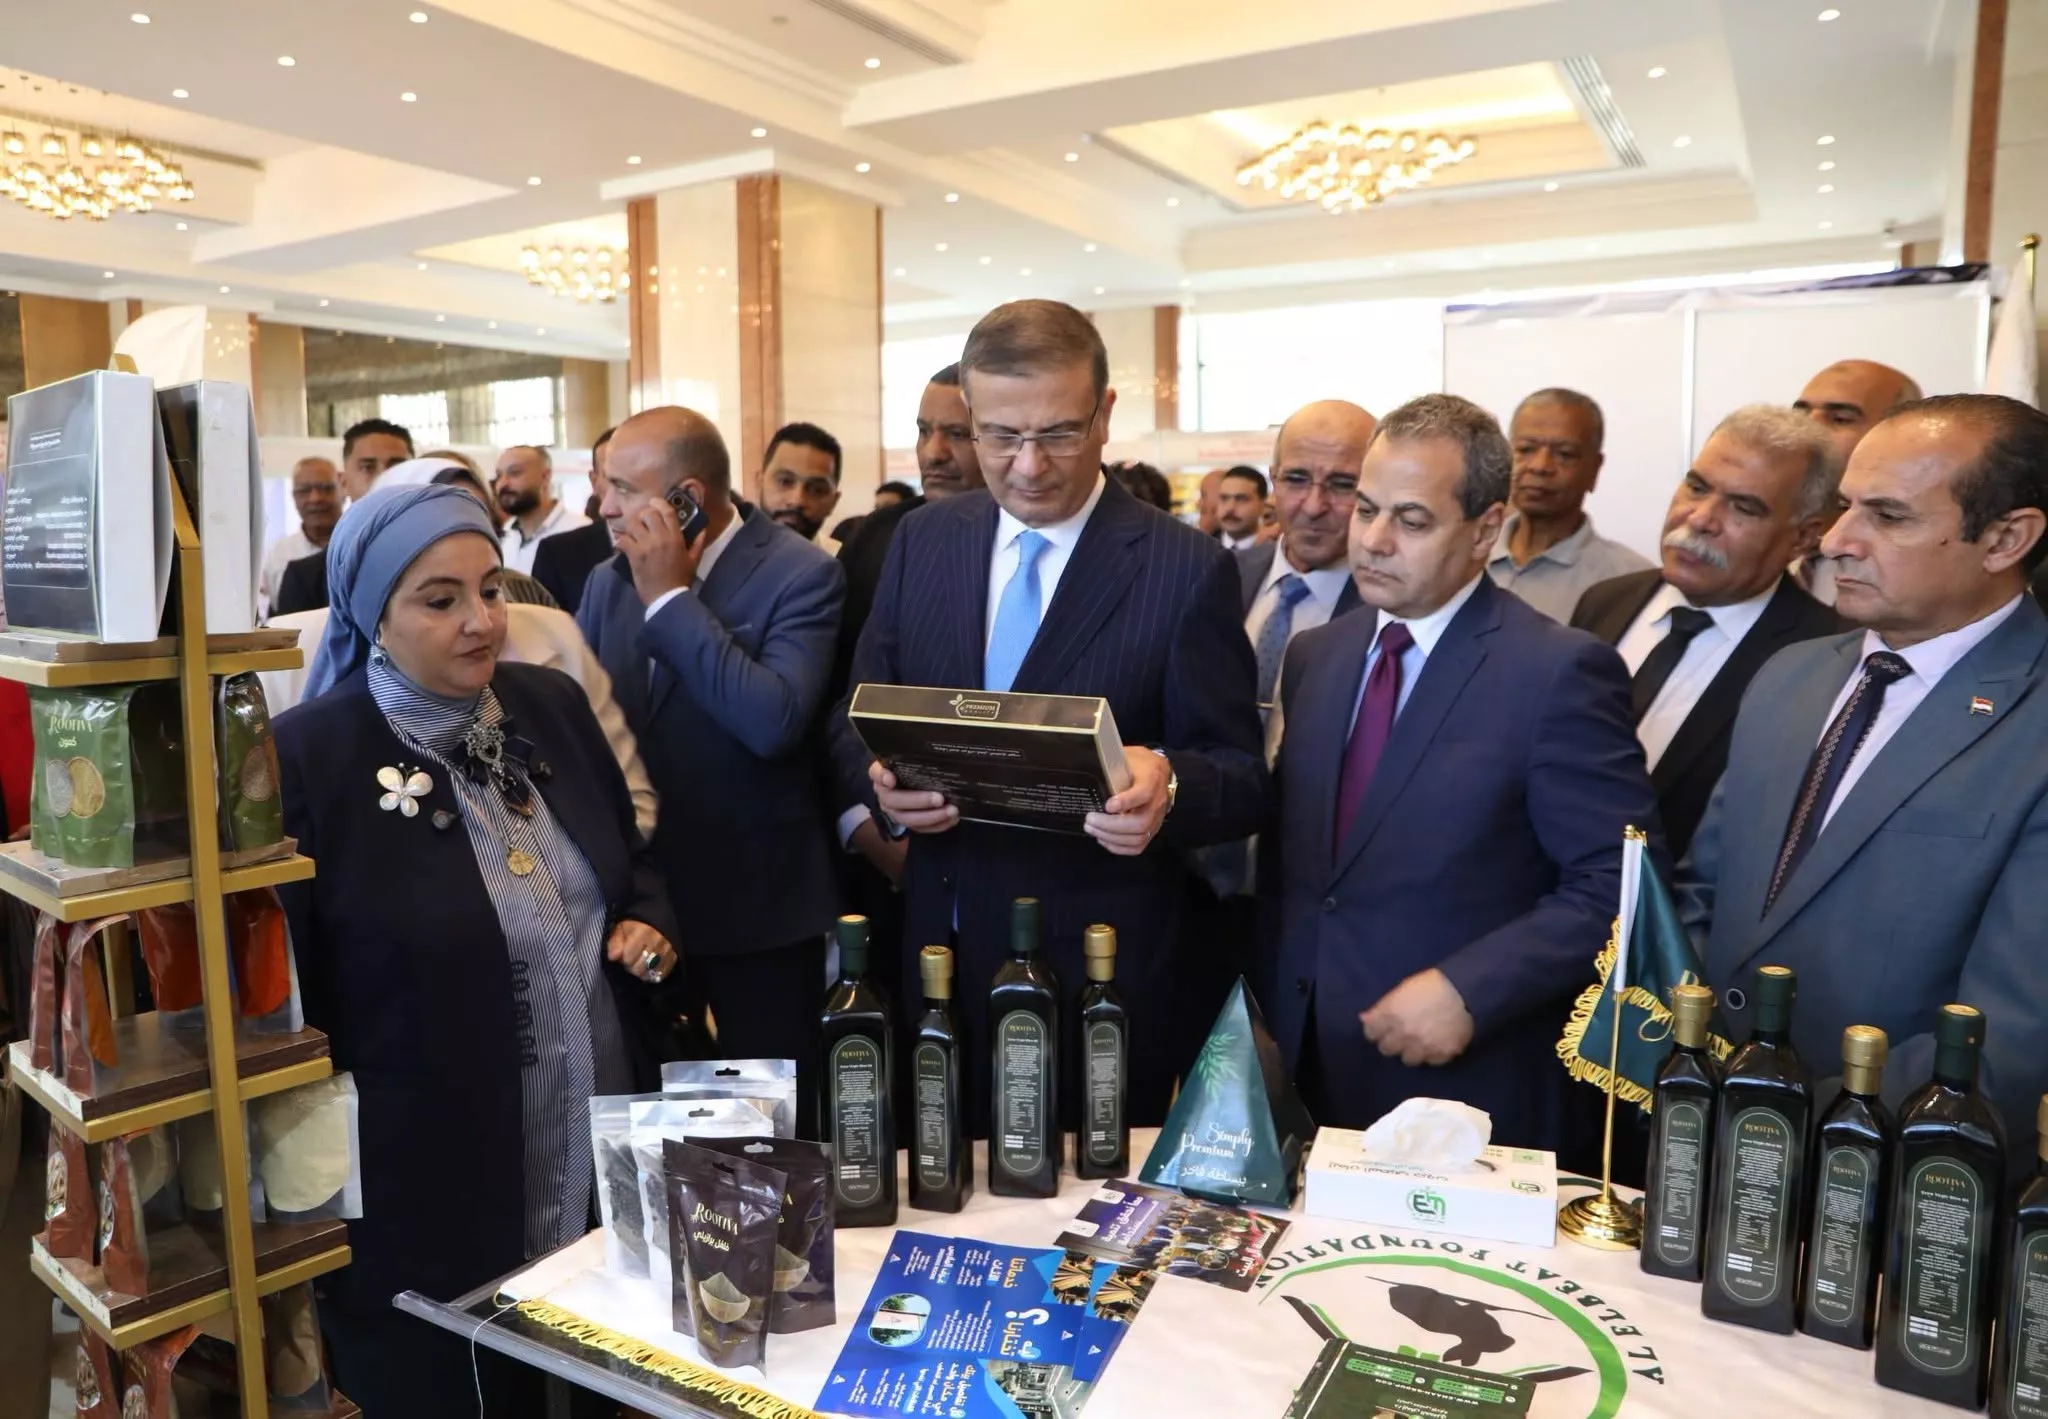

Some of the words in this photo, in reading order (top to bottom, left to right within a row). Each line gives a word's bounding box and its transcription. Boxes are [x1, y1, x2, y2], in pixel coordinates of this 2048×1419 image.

[690, 1202, 739, 1236] ROOTIVA
[1003, 1257, 1027, 1288] خدماتنا
[1237, 1254, 1256, 1278] البيت
[999, 1322, 1021, 1357] تختارنا
[1017, 1339, 1037, 1358] ليه
